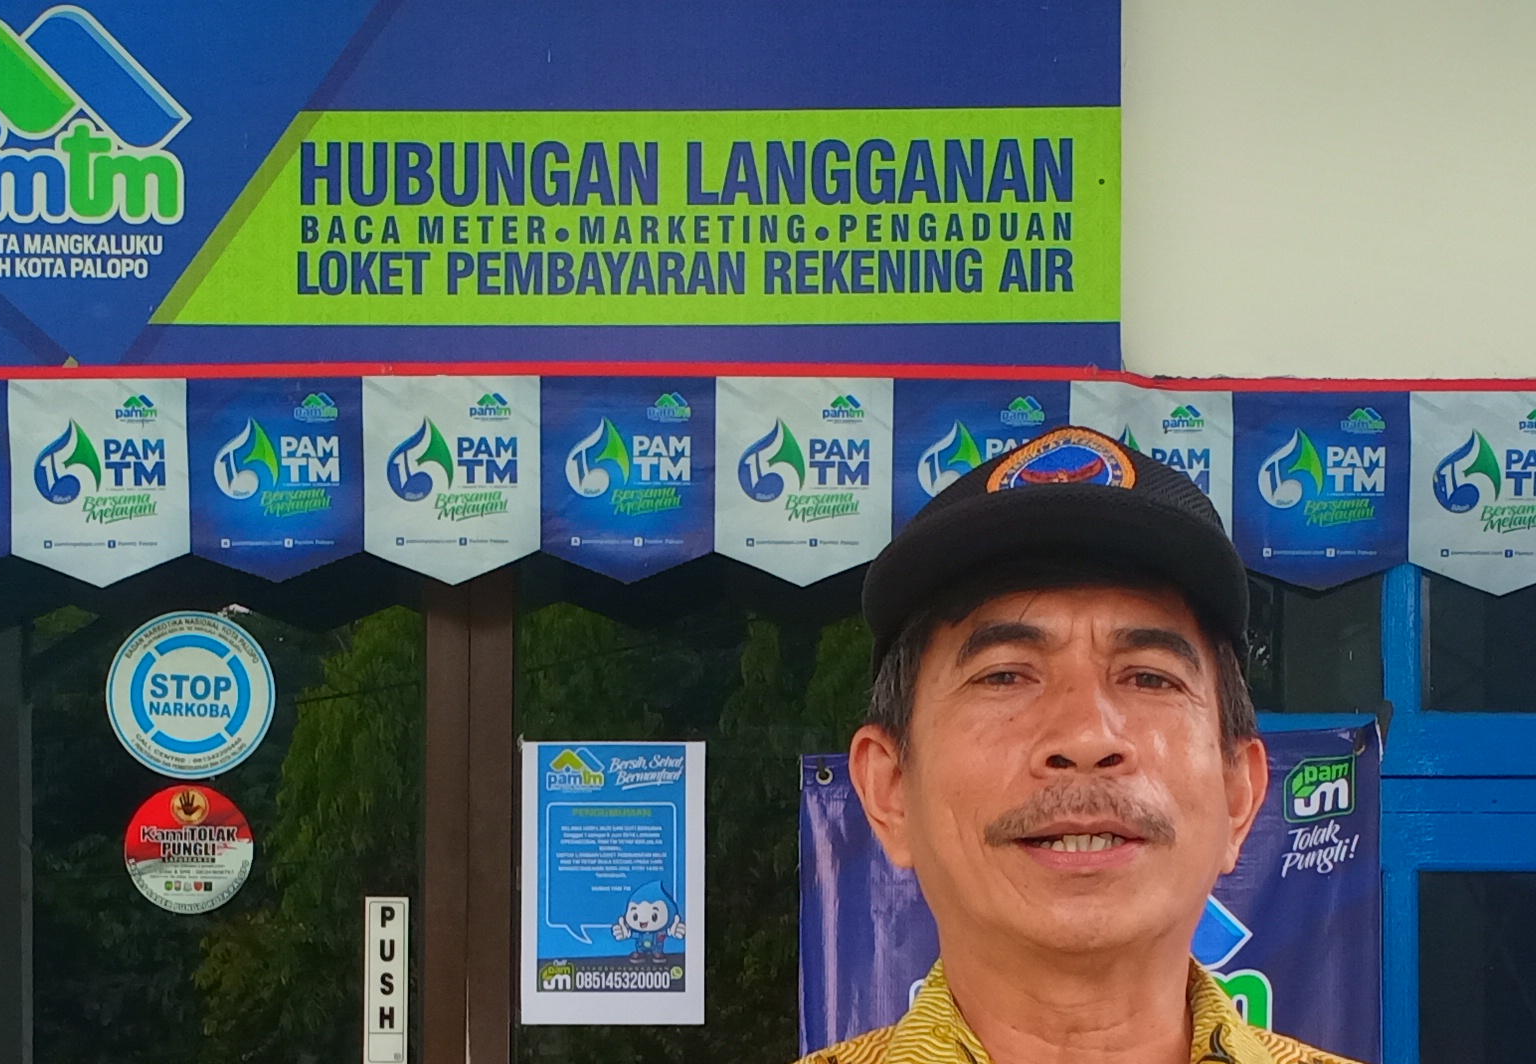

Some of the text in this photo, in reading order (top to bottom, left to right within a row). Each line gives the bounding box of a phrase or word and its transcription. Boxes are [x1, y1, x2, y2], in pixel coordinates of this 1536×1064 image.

[300, 138, 1073, 207] HUBUNGAN LANGGANAN
[301, 216, 400, 243] BACA
[419, 216, 545, 243] METER
[840, 212, 1071, 242] PENGADUAN
[24, 235, 162, 255] MANGKALUKU
[16, 258, 66, 278] KOTA
[71, 258, 148, 278] PALOPO
[297, 249, 1073, 295] LOKET PEMBAYARAN REKENING AIR
[104, 439, 164, 460] PAM
[281, 436, 339, 457] PAM
[457, 437, 517, 458] PAM
[633, 436, 691, 456] PAM
[810, 439, 870, 460] PAM
[105, 461, 166, 486] TM
[281, 457, 340, 483] TM
[458, 460, 517, 484] TM
[633, 457, 690, 482] TM
[810, 461, 870, 485] TM
[83, 495, 150, 512] Bersama
[435, 489, 502, 510] Bersama
[437, 499, 508, 521] Melayani
[785, 493, 853, 511] Bersama
[86, 502, 158, 524] Melayani
[788, 502, 860, 522] Melayani
[125, 638, 144, 659] BADAN
[185, 618, 219, 630] NASIONAL
[222, 626, 239, 641] KOTA
[238, 638, 259, 664] PALOPO
[150, 674, 232, 700] STOP
[149, 702, 231, 718] NARKOBA
[1303, 762, 1349, 785] pam
[1287, 820, 1342, 850] Tolak
[161, 843, 216, 856] PUNGLI
[1281, 834, 1360, 878] Pungli!
[378, 905, 396, 1029] PUSH
[576, 973, 670, 989] 085145320000
